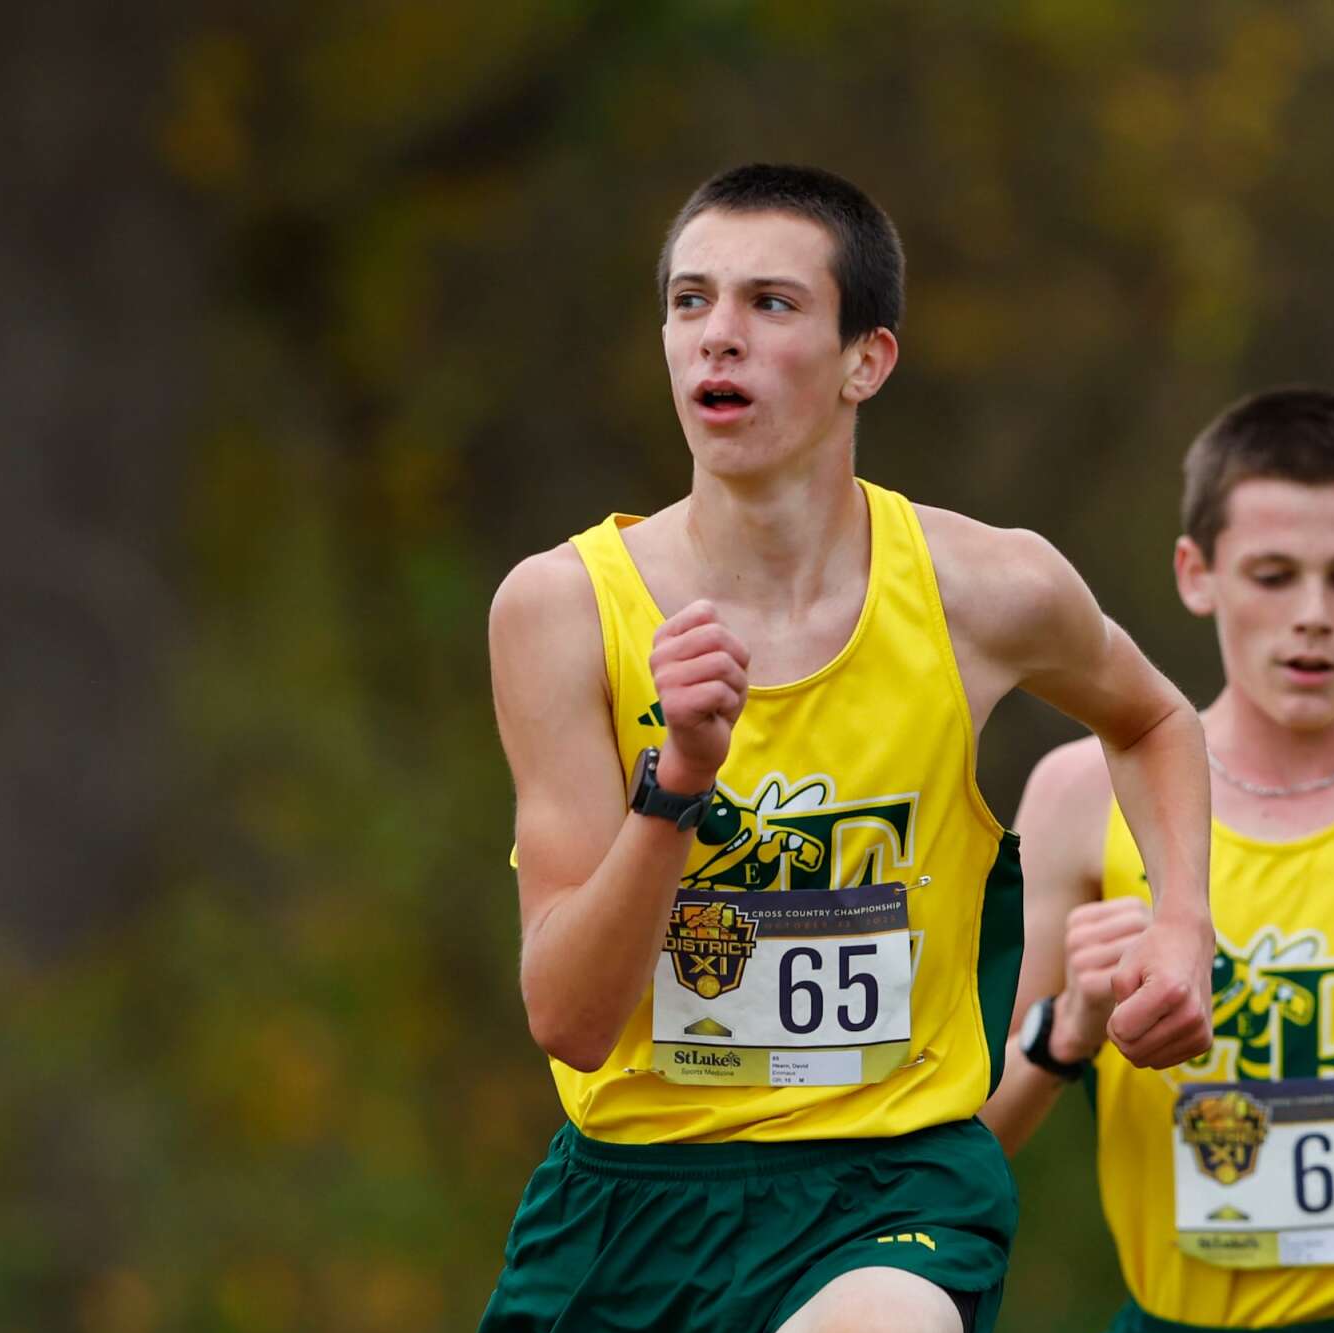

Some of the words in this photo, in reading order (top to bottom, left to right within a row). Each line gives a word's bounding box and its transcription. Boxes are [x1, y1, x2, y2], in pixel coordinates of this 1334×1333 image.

[752, 909, 783, 918] CROSS
[786, 908, 830, 917] COUNTRY
[833, 901, 902, 917] CHAMPIONSHIP
[666, 937, 755, 956] DISTRICT
[689, 954, 728, 976] XI
[778, 943, 879, 1035] 65
